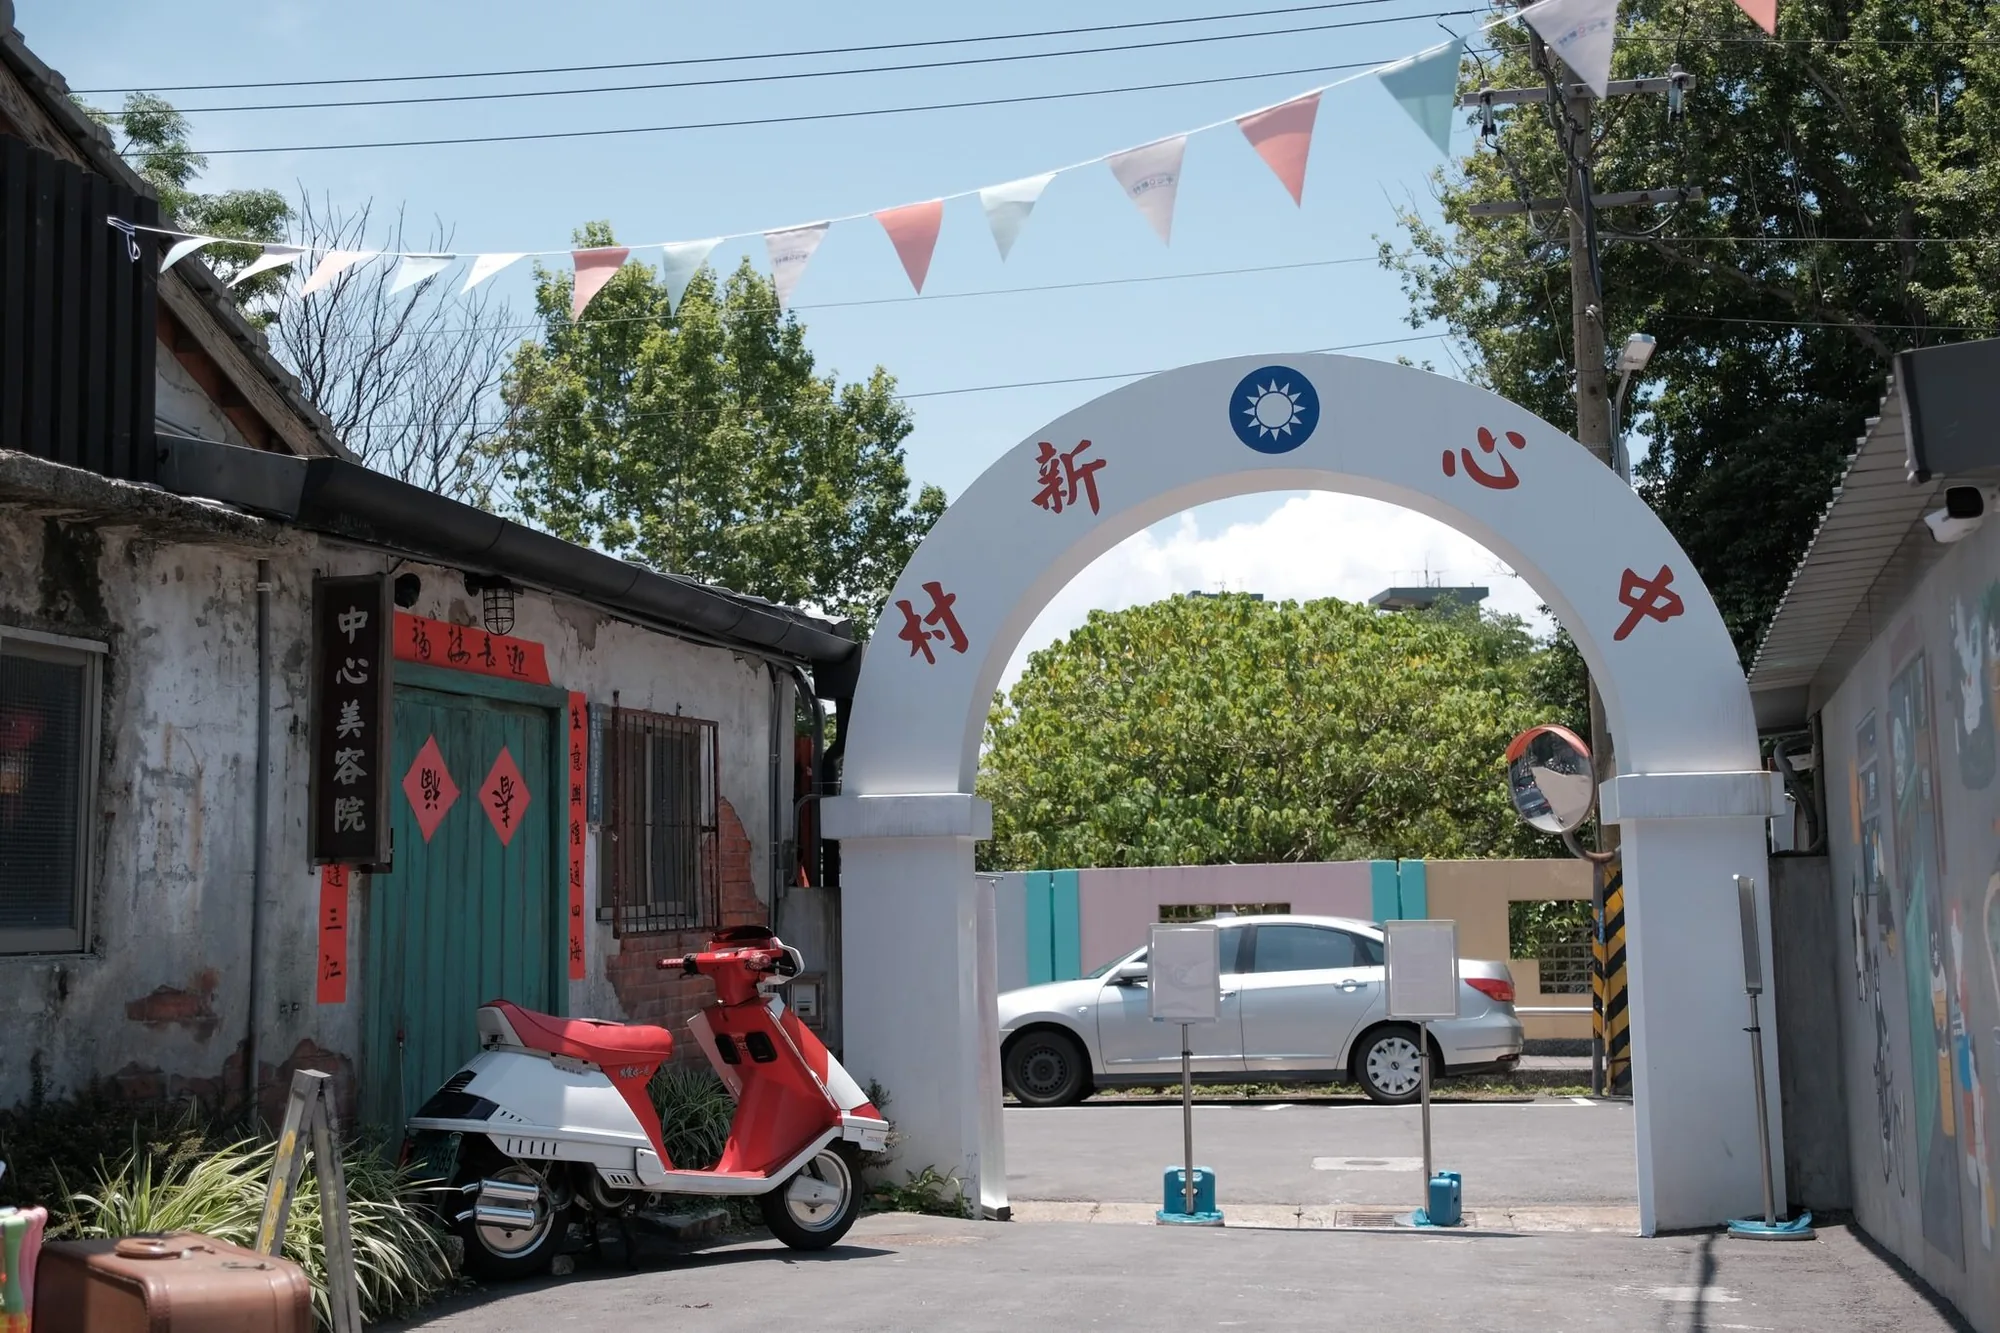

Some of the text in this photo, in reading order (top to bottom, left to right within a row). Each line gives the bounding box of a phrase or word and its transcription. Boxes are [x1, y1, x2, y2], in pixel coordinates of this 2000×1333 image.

[895, 426, 1684, 664] 中心新村
[334, 607, 368, 832] 中心美容院
[421, 768, 441, 810] 福
[491, 776, 515, 828] 春
